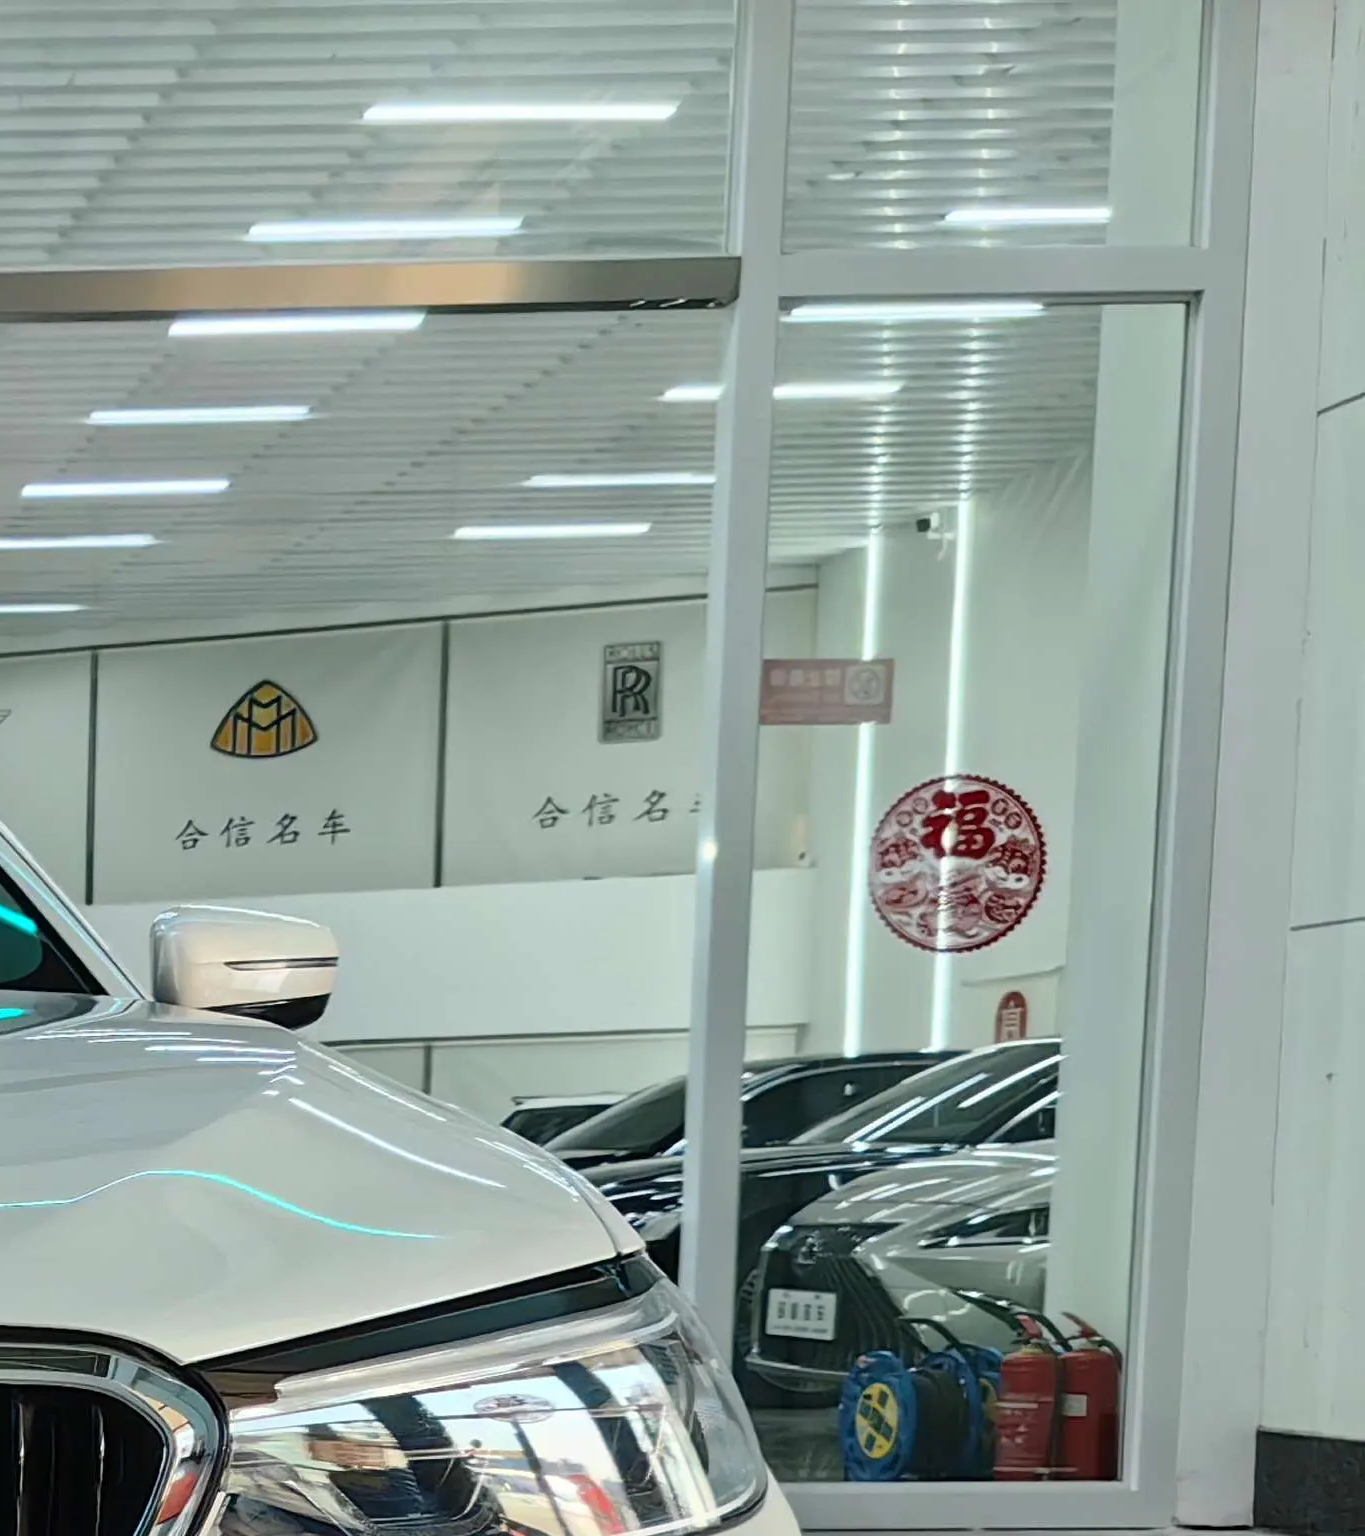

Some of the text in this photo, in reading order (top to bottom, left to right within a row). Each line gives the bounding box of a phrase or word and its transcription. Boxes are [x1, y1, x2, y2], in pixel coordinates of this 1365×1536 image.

[175, 808, 351, 850] 合信名车
[921, 790, 996, 859] 福
